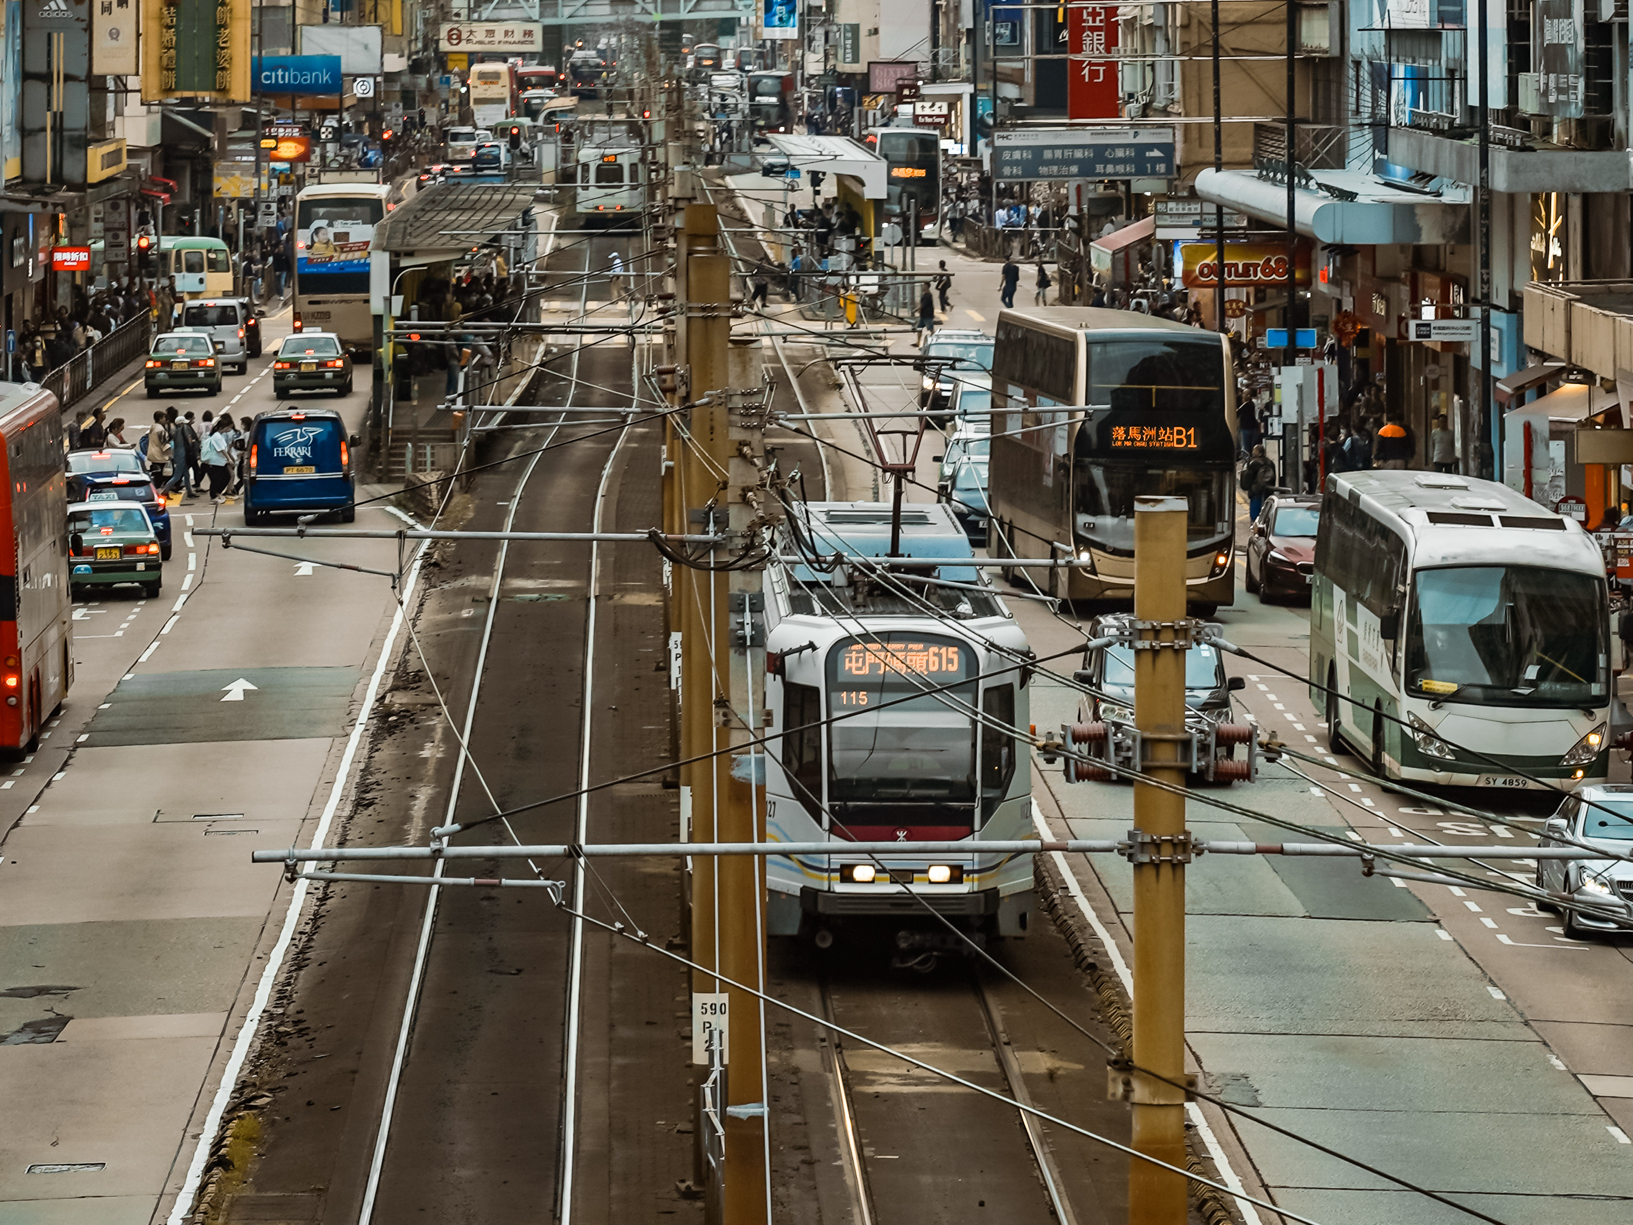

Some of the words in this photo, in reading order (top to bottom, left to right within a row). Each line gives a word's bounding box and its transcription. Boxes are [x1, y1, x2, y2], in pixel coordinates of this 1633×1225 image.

[38, 9, 73, 18] adidas
[261, 68, 332, 85] citibank
[1112, 426, 1173, 441] 落馬洲站
[1173, 426, 1197, 448] B1
[273, 446, 313, 458] FERRARI
[845, 651, 928, 675] 屯門碼頭
[928, 646, 959, 672] 615
[841, 691, 868, 705] 115
[1485, 776, 1497, 786] SY
[1502, 777, 1527, 788] 4859
[701, 1002, 727, 1015] 590
